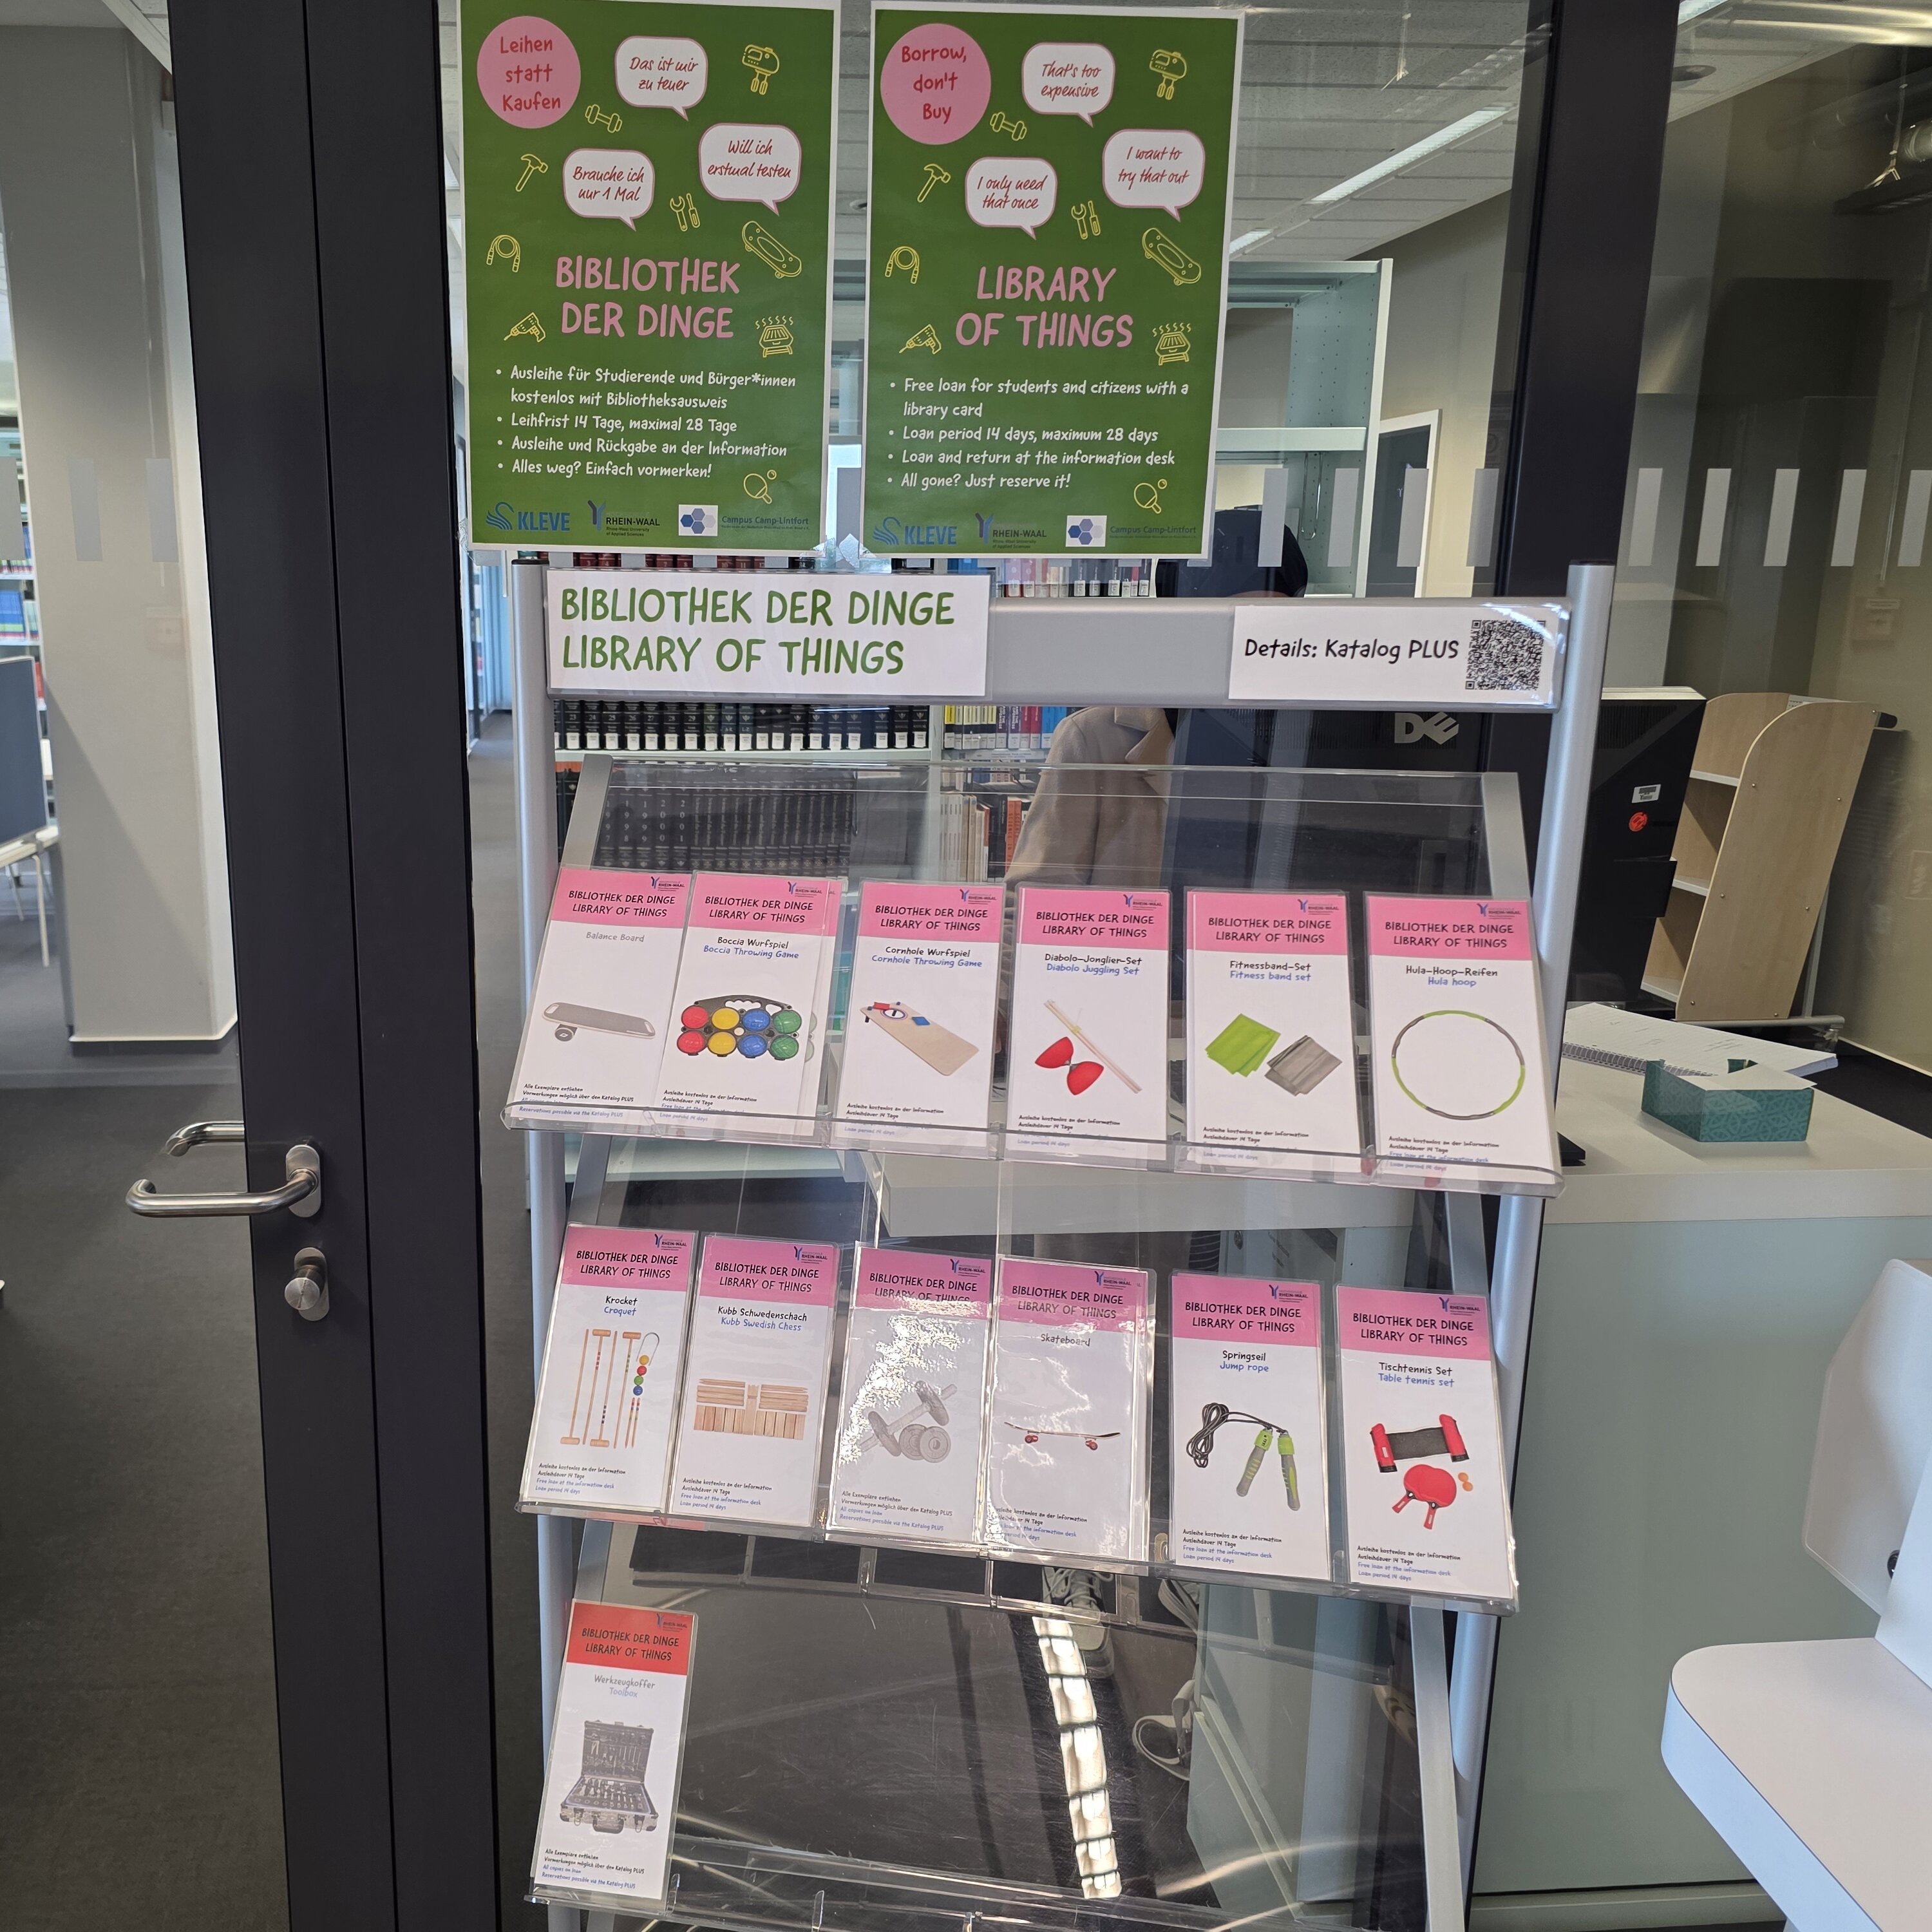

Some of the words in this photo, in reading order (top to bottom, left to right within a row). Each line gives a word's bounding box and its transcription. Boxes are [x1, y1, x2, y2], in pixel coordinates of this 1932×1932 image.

[500, 35, 552, 53] Leihen
[902, 46, 966, 62] Borrow,
[629, 57, 654, 70] Das
[658, 57, 674, 71] ist
[676, 62, 698, 72] mir
[1042, 61, 1077, 77] That's
[1082, 64, 1101, 77] too
[506, 64, 553, 83] statt
[639, 80, 653, 90] zu
[658, 77, 689, 91] teuer
[913, 72, 958, 93] don't
[1041, 83, 1099, 101] expensive
[502, 93, 560, 112] Kaufen
[923, 103, 951, 124] Buy
[728, 140, 753, 154] Will
[755, 139, 772, 155] ich
[1127, 147, 1133, 160] I
[1135, 147, 1168, 160] want
[1169, 147, 1182, 160] to
[573, 166, 624, 182] Brauche
[627, 167, 644, 182] ich
[708, 162, 753, 177] erstmal
[757, 164, 791, 178] testen
[978, 176, 983, 189] I
[986, 176, 1011, 198] only
[1016, 175, 1048, 191] need
[1119, 169, 1136, 190] try
[1140, 167, 1167, 182] that
[1168, 170, 1189, 184] out
[578, 189, 600, 200] nur
[603, 187, 611, 200] 1
[614, 187, 641, 202] Mal
[983, 194, 1009, 209] that
[1011, 197, 1039, 209] once
[556, 256, 740, 294] BIBLIOTHEK
[977, 266, 1116, 302] LIBRARY
[562, 302, 625, 337] DER
[638, 304, 734, 338] DINGE
[956, 313, 1004, 346] OF
[1016, 311, 1133, 348] THINGS
[511, 365, 563, 380] Ausleihe
[568, 366, 591, 381] für
[596, 368, 675, 384] Studierende
[680, 371, 703, 385] und
[905, 378, 933, 392] Free
[938, 378, 966, 392] loan
[971, 377, 993, 392] for
[998, 379, 1057, 394] students
[1063, 380, 1086, 394] and
[1091, 381, 1141, 394] citizens
[1146, 381, 1176, 395] with
[1181, 384, 1188, 394] a
[511, 388, 574, 404] kostenlos
[580, 392, 602, 406] mit
[607, 392, 727, 408] Bibliotheksausweis
[904, 401, 948, 420] library
[952, 402, 982, 417] card
[512, 412, 569, 428] Leihfrist
[575, 415, 587, 428] 14
[592, 416, 624, 433] Tage,
[630, 417, 681, 430] maximal
[687, 418, 703, 431] 28
[708, 419, 737, 436] Tage
[904, 426, 934, 439] Loan
[939, 426, 981, 442] period
[987, 427, 1000, 440] 14
[1005, 427, 1037, 444] days,
[1042, 429, 1101, 440] maximum
[1106, 428, 1123, 440] 28
[1128, 428, 1158, 445] days
[512, 459, 542, 473] Alles
[547, 461, 581, 478] weg?
[587, 461, 632, 476] Einfach
[638, 463, 712, 477] vormerken!
[901, 473, 917, 486] All
[922, 473, 961, 491] gone?
[965, 473, 996, 488] Just
[1000, 477, 1050, 487] reserve
[1055, 473, 1071, 488] it!
[518, 512, 570, 531] KLEVE
[607, 517, 660, 526] RHEIN-WAAL
[722, 516, 752, 525] Campus
[755, 516, 808, 526] Camp-Lintfort
[562, 587, 752, 625] BIBLIOTHEK
[767, 589, 833, 626] DER
[848, 590, 954, 625] DINGE
[564, 635, 701, 672] LIBRARY
[716, 639, 766, 672] OF
[779, 637, 904, 676] THINGS
[1245, 638, 1317, 658] Details:
[1325, 639, 1400, 664] Katalog
[1409, 640, 1459, 658] PLUS
[620, 934, 645, 942] Board
[718, 937, 744, 945] Boccia
[748, 939, 788, 949] Wurfspiel
[704, 945, 730, 954] Boccia
[734, 947, 773, 959] Throwing
[928, 949, 971, 958] Wurfspiel
[872, 955, 910, 963] Cornhole
[914, 958, 954, 968] Throwing
[1047, 963, 1079, 972] Diabolo
[1083, 965, 1119, 976] Juggling
[1124, 967, 1139, 975] Set
[1230, 971, 1265, 979] Fitness
[1269, 972, 1291, 980] band
[1452, 978, 1477, 987] hoop
[606, 1296, 638, 1305] Krocket
[604, 1307, 636, 1317] Croquet
[718, 1306, 737, 1315] Kubb
[741, 1309, 806, 1321] Schwedenschach
[721, 1317, 740, 1325] Kubb
[744, 1319, 775, 1329] Swedish
[779, 1322, 801, 1331] Chess
[1041, 1333, 1090, 1347] Skateboard
[1223, 1350, 1265, 1362] Springseil
[1220, 1361, 1244, 1372] Jump
[1379, 1362, 1432, 1374] Tischtennis
[1436, 1367, 1452, 1376] Set
[1378, 1373, 1401, 1382] Table
[1405, 1376, 1435, 1385] tennis
[1439, 1379, 1454, 1387] set
[703, 1479, 725, 1487] kostenlos
[582, 1628, 630, 1641] BIBLIOTHEK
[634, 1634, 650, 1644] DER
[653, 1636, 679, 1646] DINGE
[586, 1643, 621, 1655] LIBRARY
[625, 1647, 638, 1657] OF
[641, 1649, 672, 1661] THINGS
[594, 1674, 656, 1690] Werkzeugkoffer
[609, 1687, 638, 1698] Toolbox
